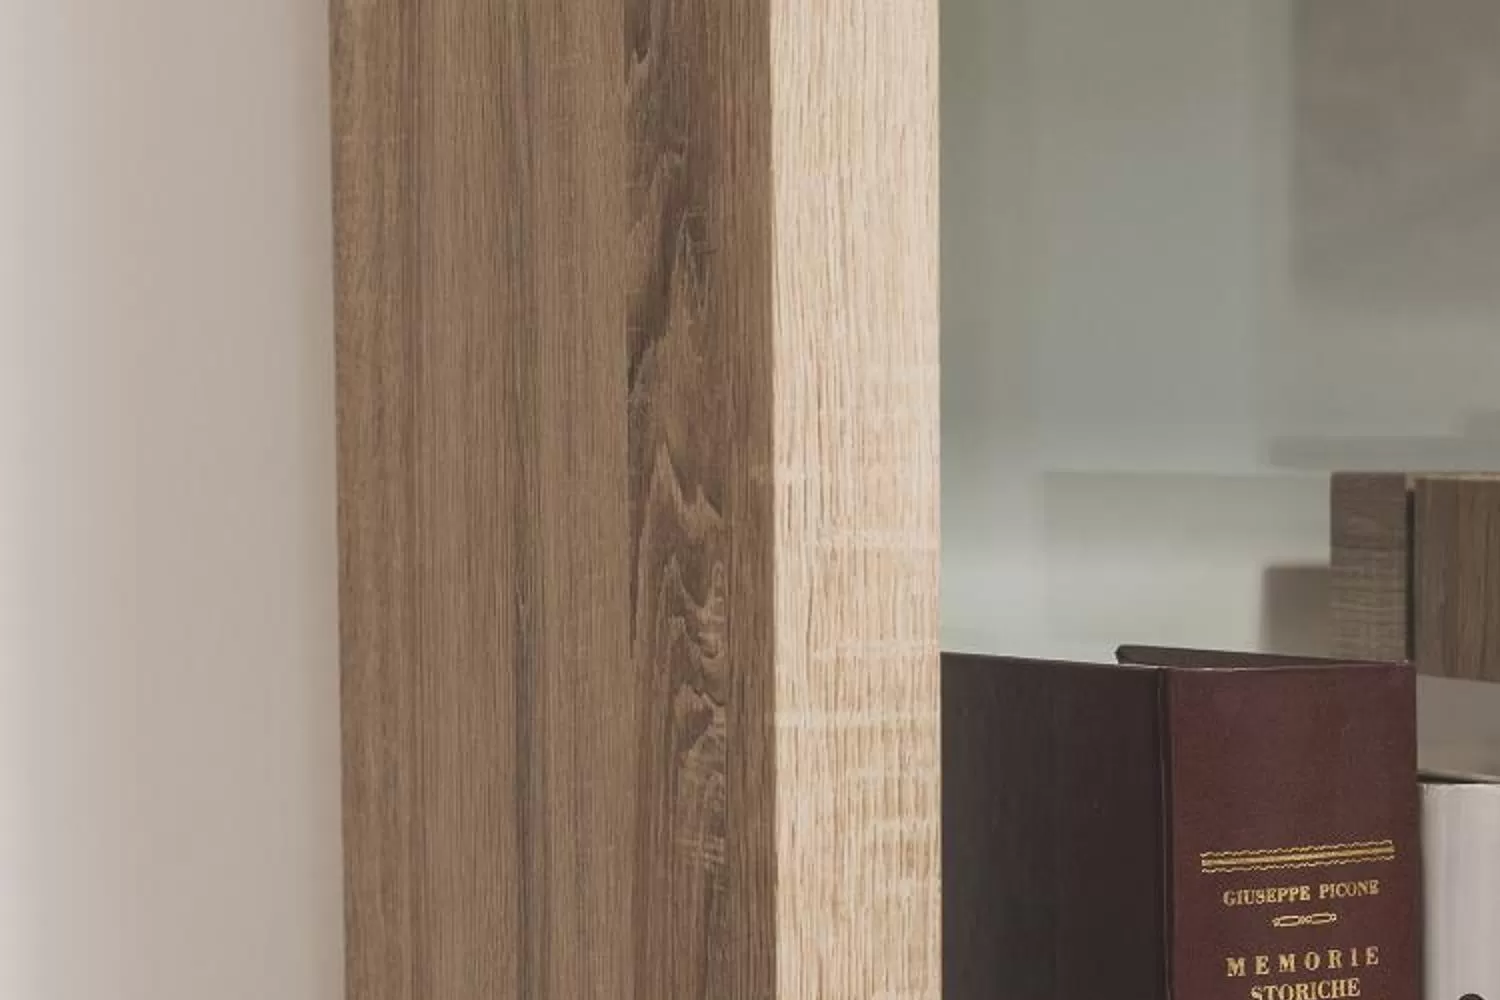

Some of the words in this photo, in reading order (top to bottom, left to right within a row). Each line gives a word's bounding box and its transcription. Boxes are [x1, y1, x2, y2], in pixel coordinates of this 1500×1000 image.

[1222, 885, 1311, 907] GIUSEPPE
[1319, 879, 1380, 899] PICONE
[1225, 945, 1381, 977] MEMORIE
